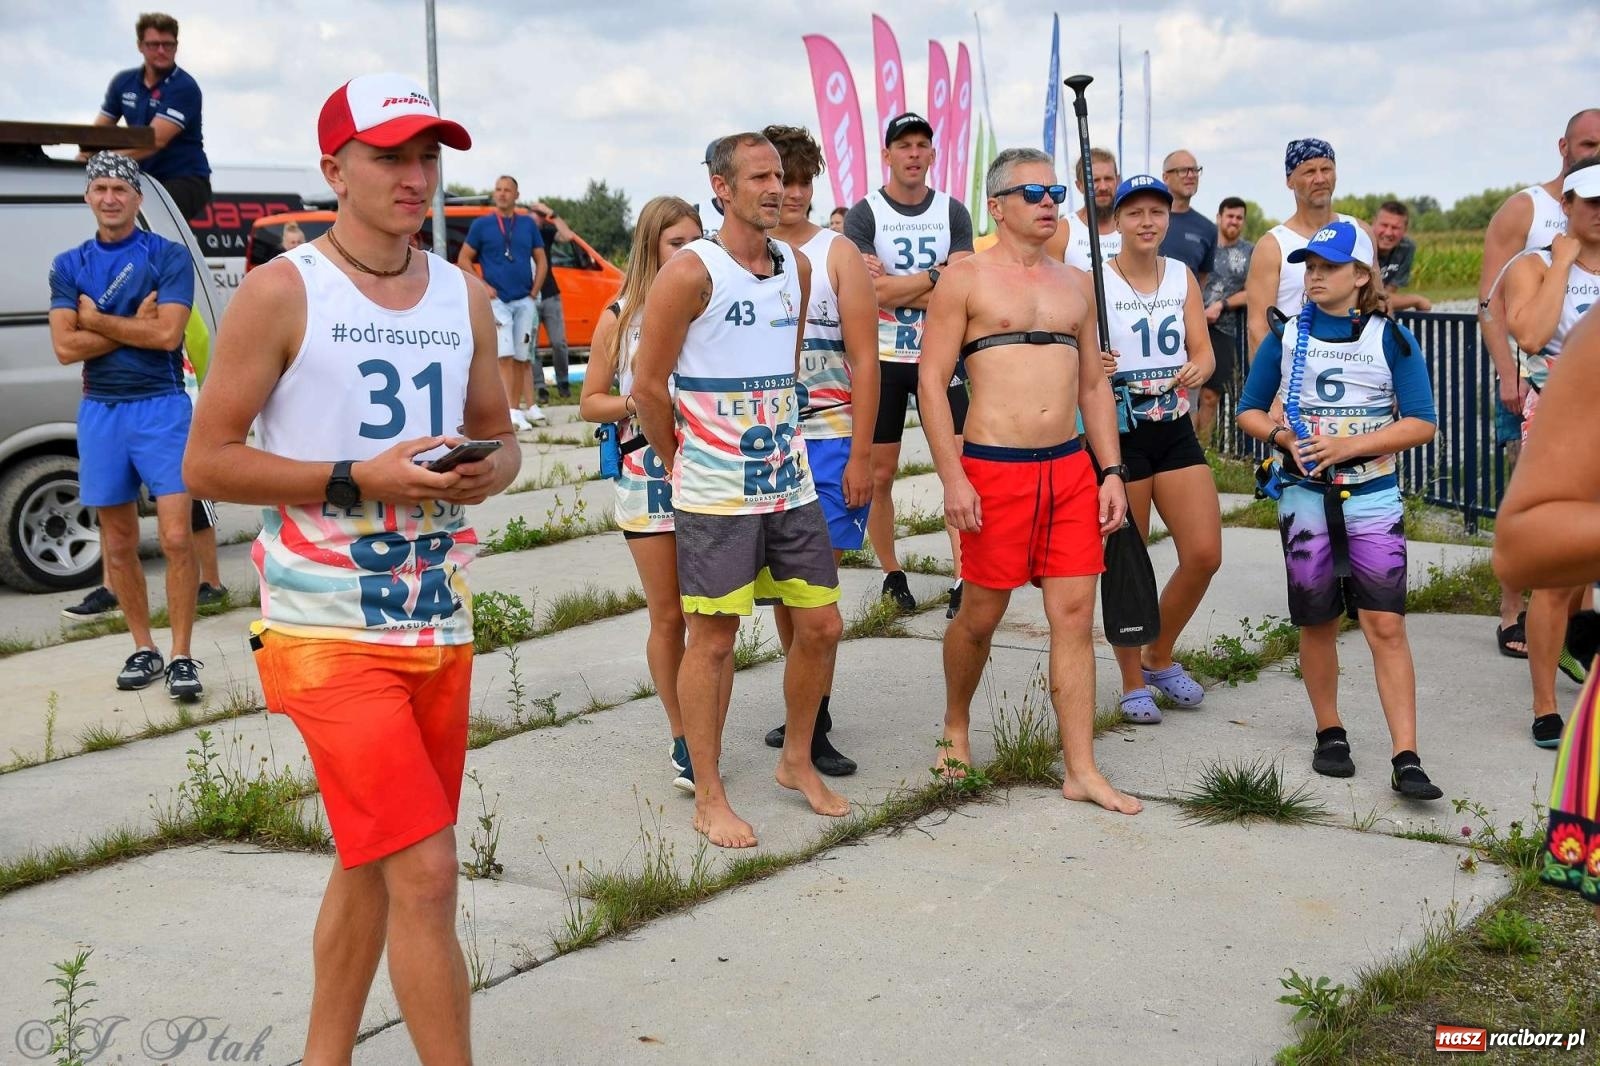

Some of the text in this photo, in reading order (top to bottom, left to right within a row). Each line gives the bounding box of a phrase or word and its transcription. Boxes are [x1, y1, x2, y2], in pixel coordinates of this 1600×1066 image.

[882, 222, 944, 232] #odrasupcup
[1545, 219, 1568, 229] #od
[893, 236, 937, 269] 35
[725, 300, 756, 327] 43
[331, 322, 461, 350] #odrasupcup
[1131, 315, 1181, 357] 16
[357, 358, 443, 440] 31
[1315, 367, 1346, 403] 6
